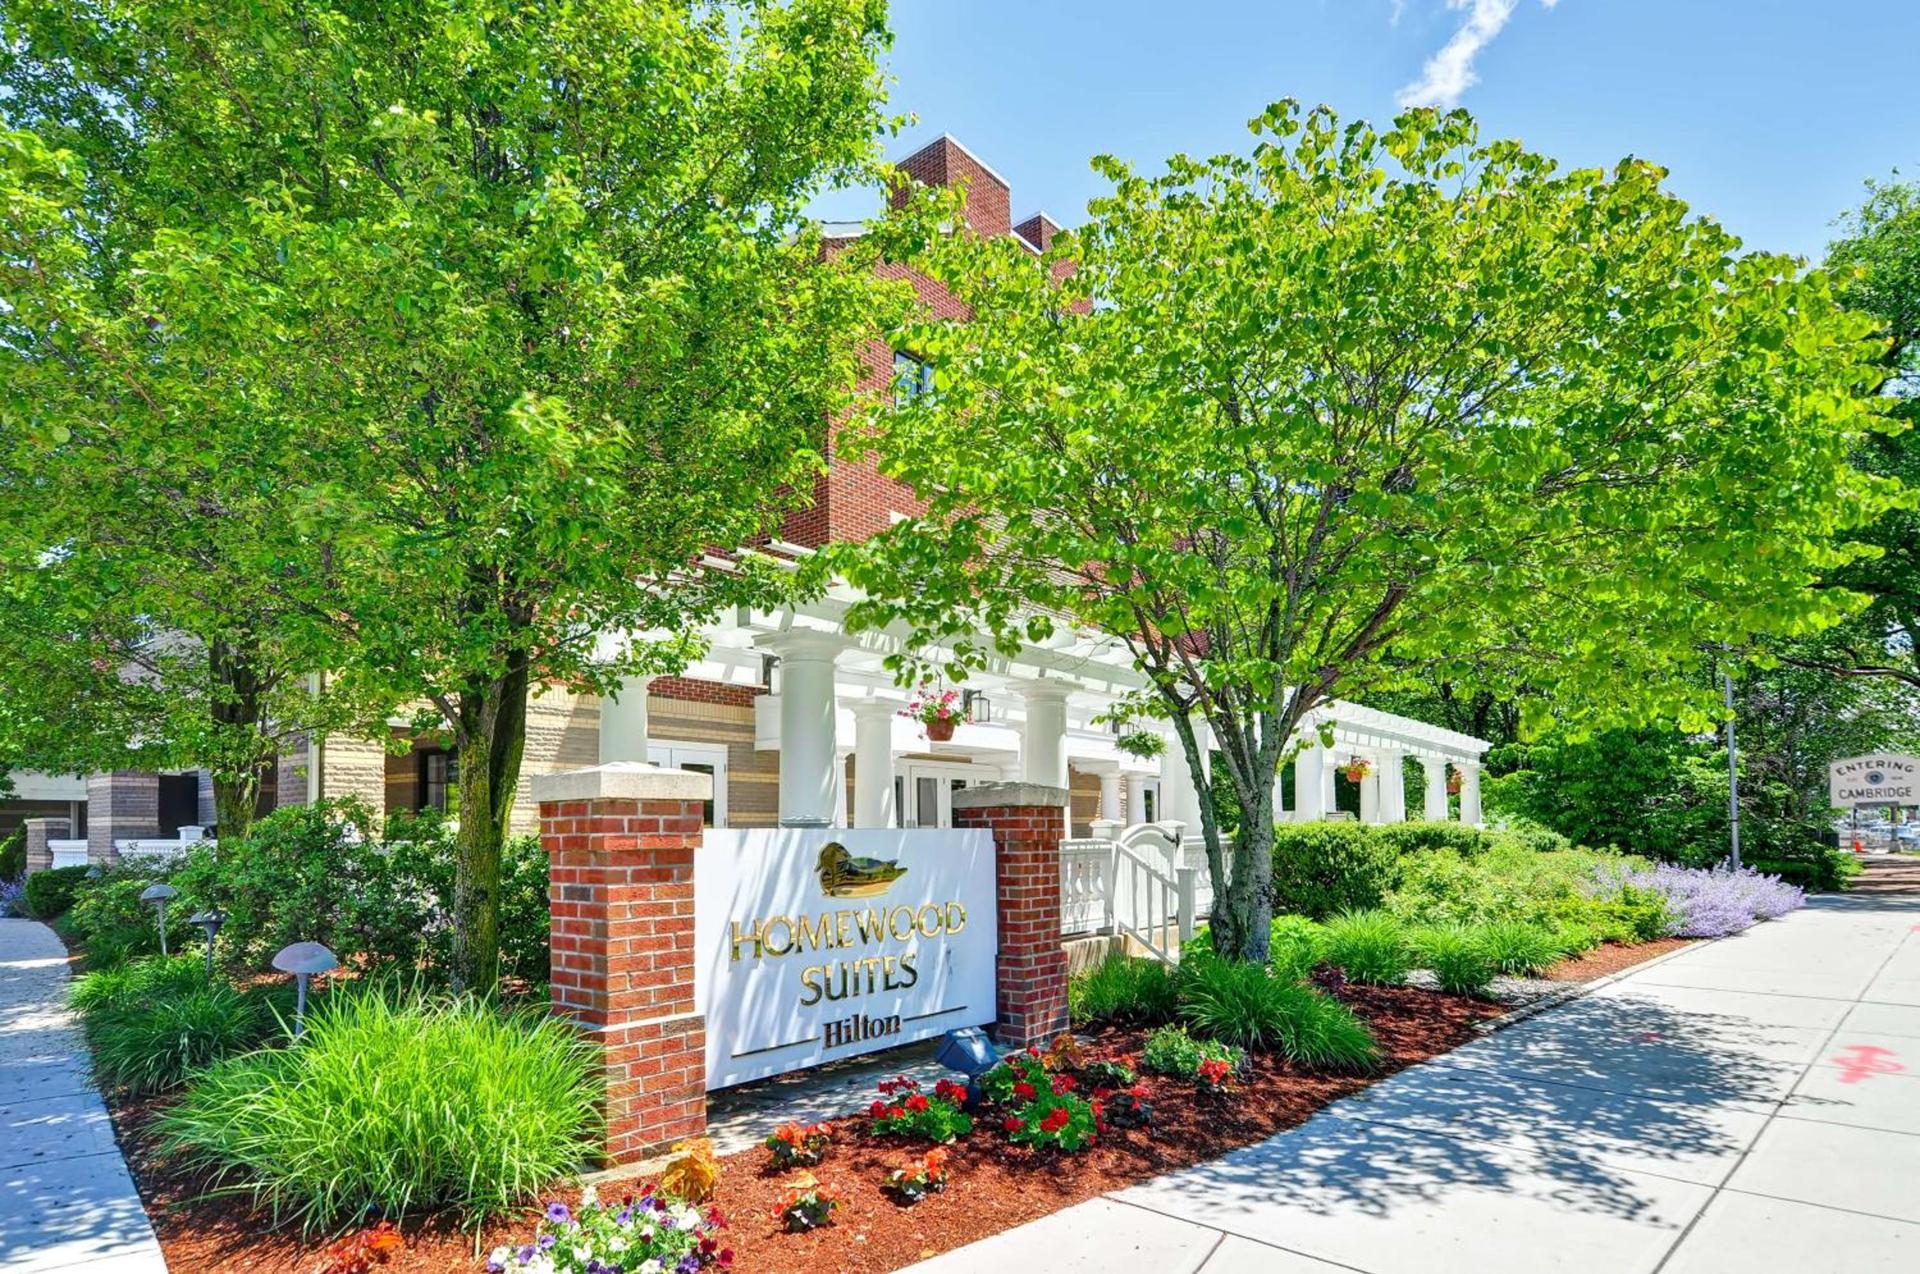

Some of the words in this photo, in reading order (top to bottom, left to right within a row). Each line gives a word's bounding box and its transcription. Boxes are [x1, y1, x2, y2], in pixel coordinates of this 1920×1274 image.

[1836, 760, 1914, 776] ENTERING
[1838, 787, 1912, 799] CAMBRIDGE
[730, 901, 967, 961] HOMEWOOD
[800, 953, 918, 1007] SUITES
[823, 1013, 901, 1049] Hilton
